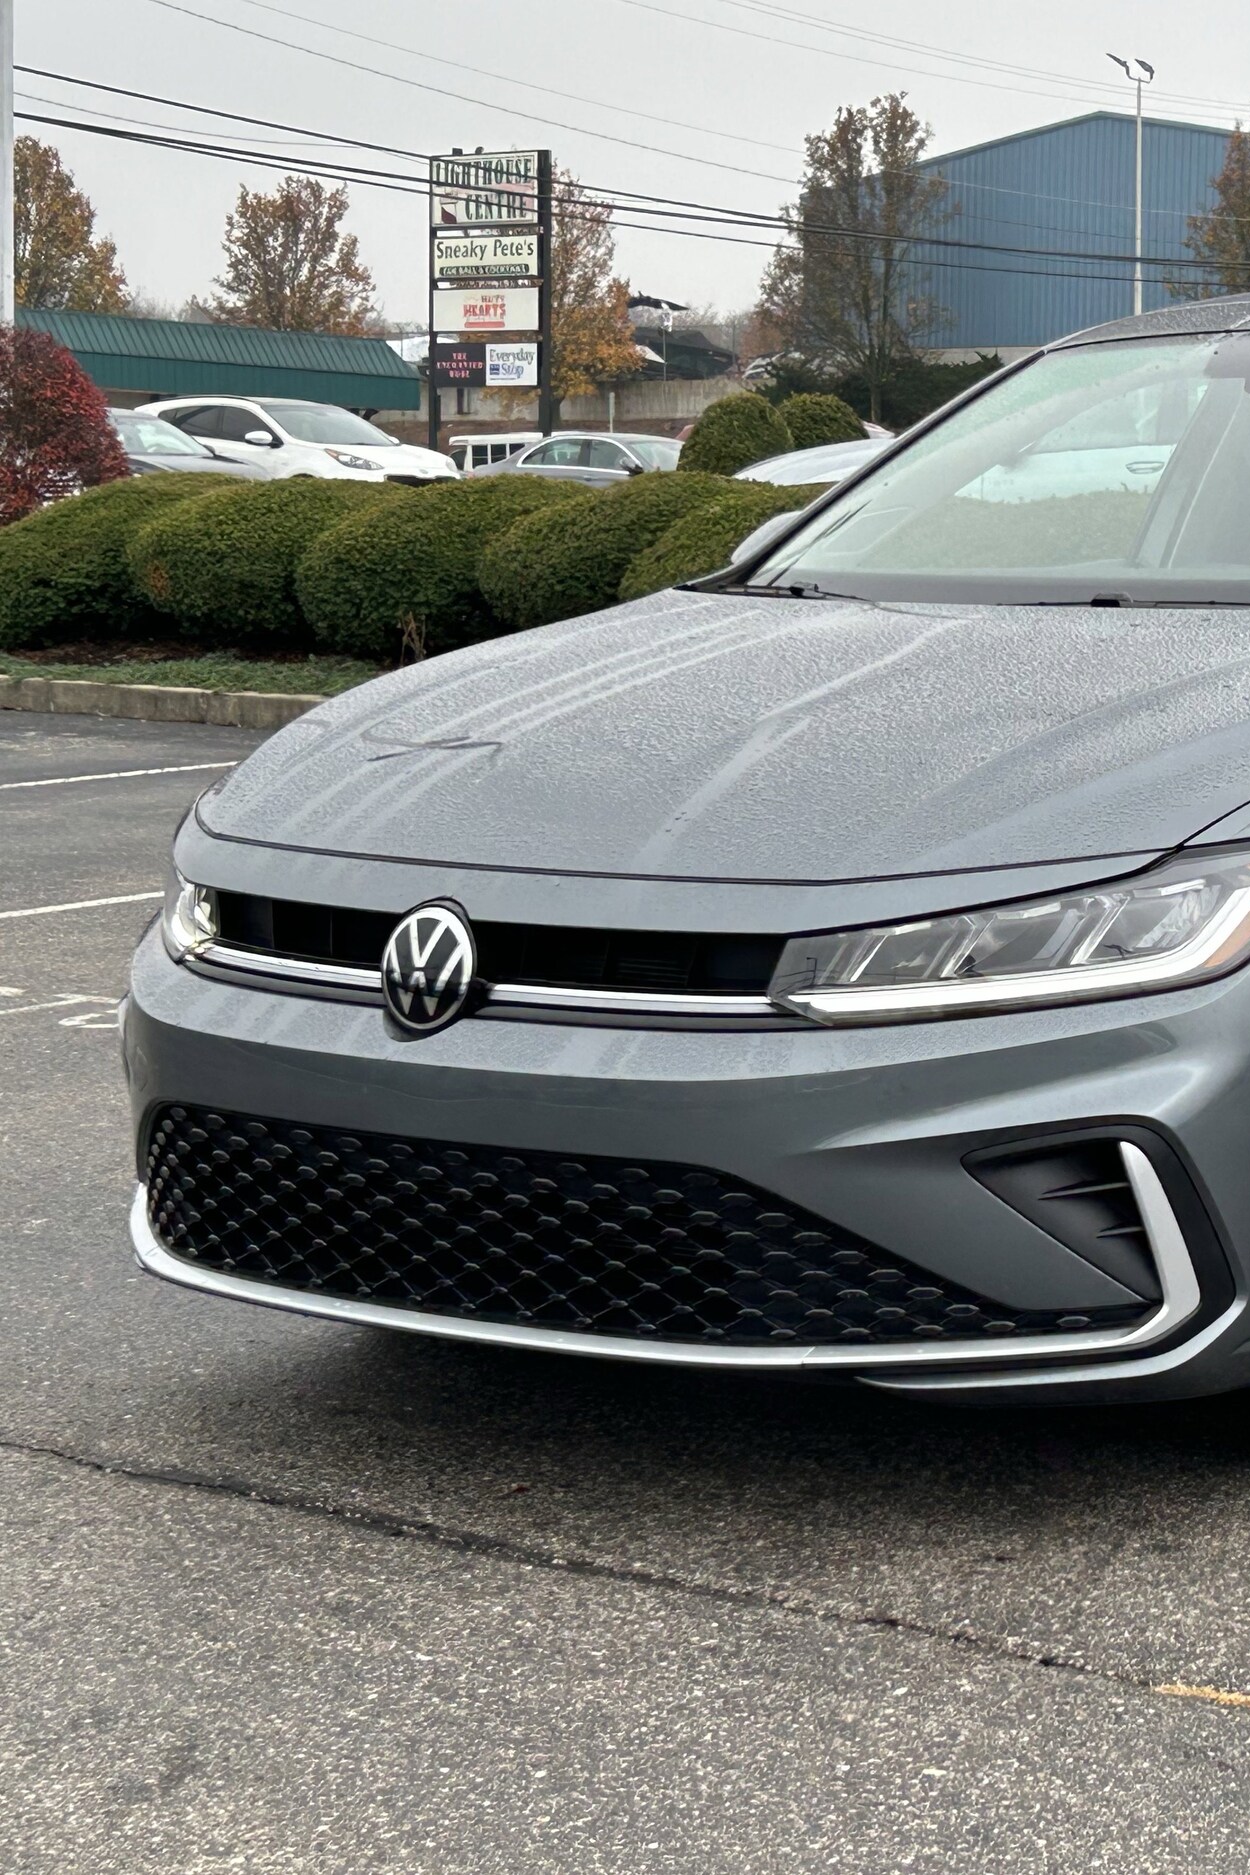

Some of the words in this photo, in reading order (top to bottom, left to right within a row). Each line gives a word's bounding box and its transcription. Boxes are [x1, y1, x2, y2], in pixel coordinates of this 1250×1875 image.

[435, 158, 532, 187] LIGHTHOUSE
[465, 191, 527, 220] CENTRE
[436, 240, 488, 261] Sneaky
[493, 239, 534, 257] Pete's
[383, 906, 473, 1030] VW
